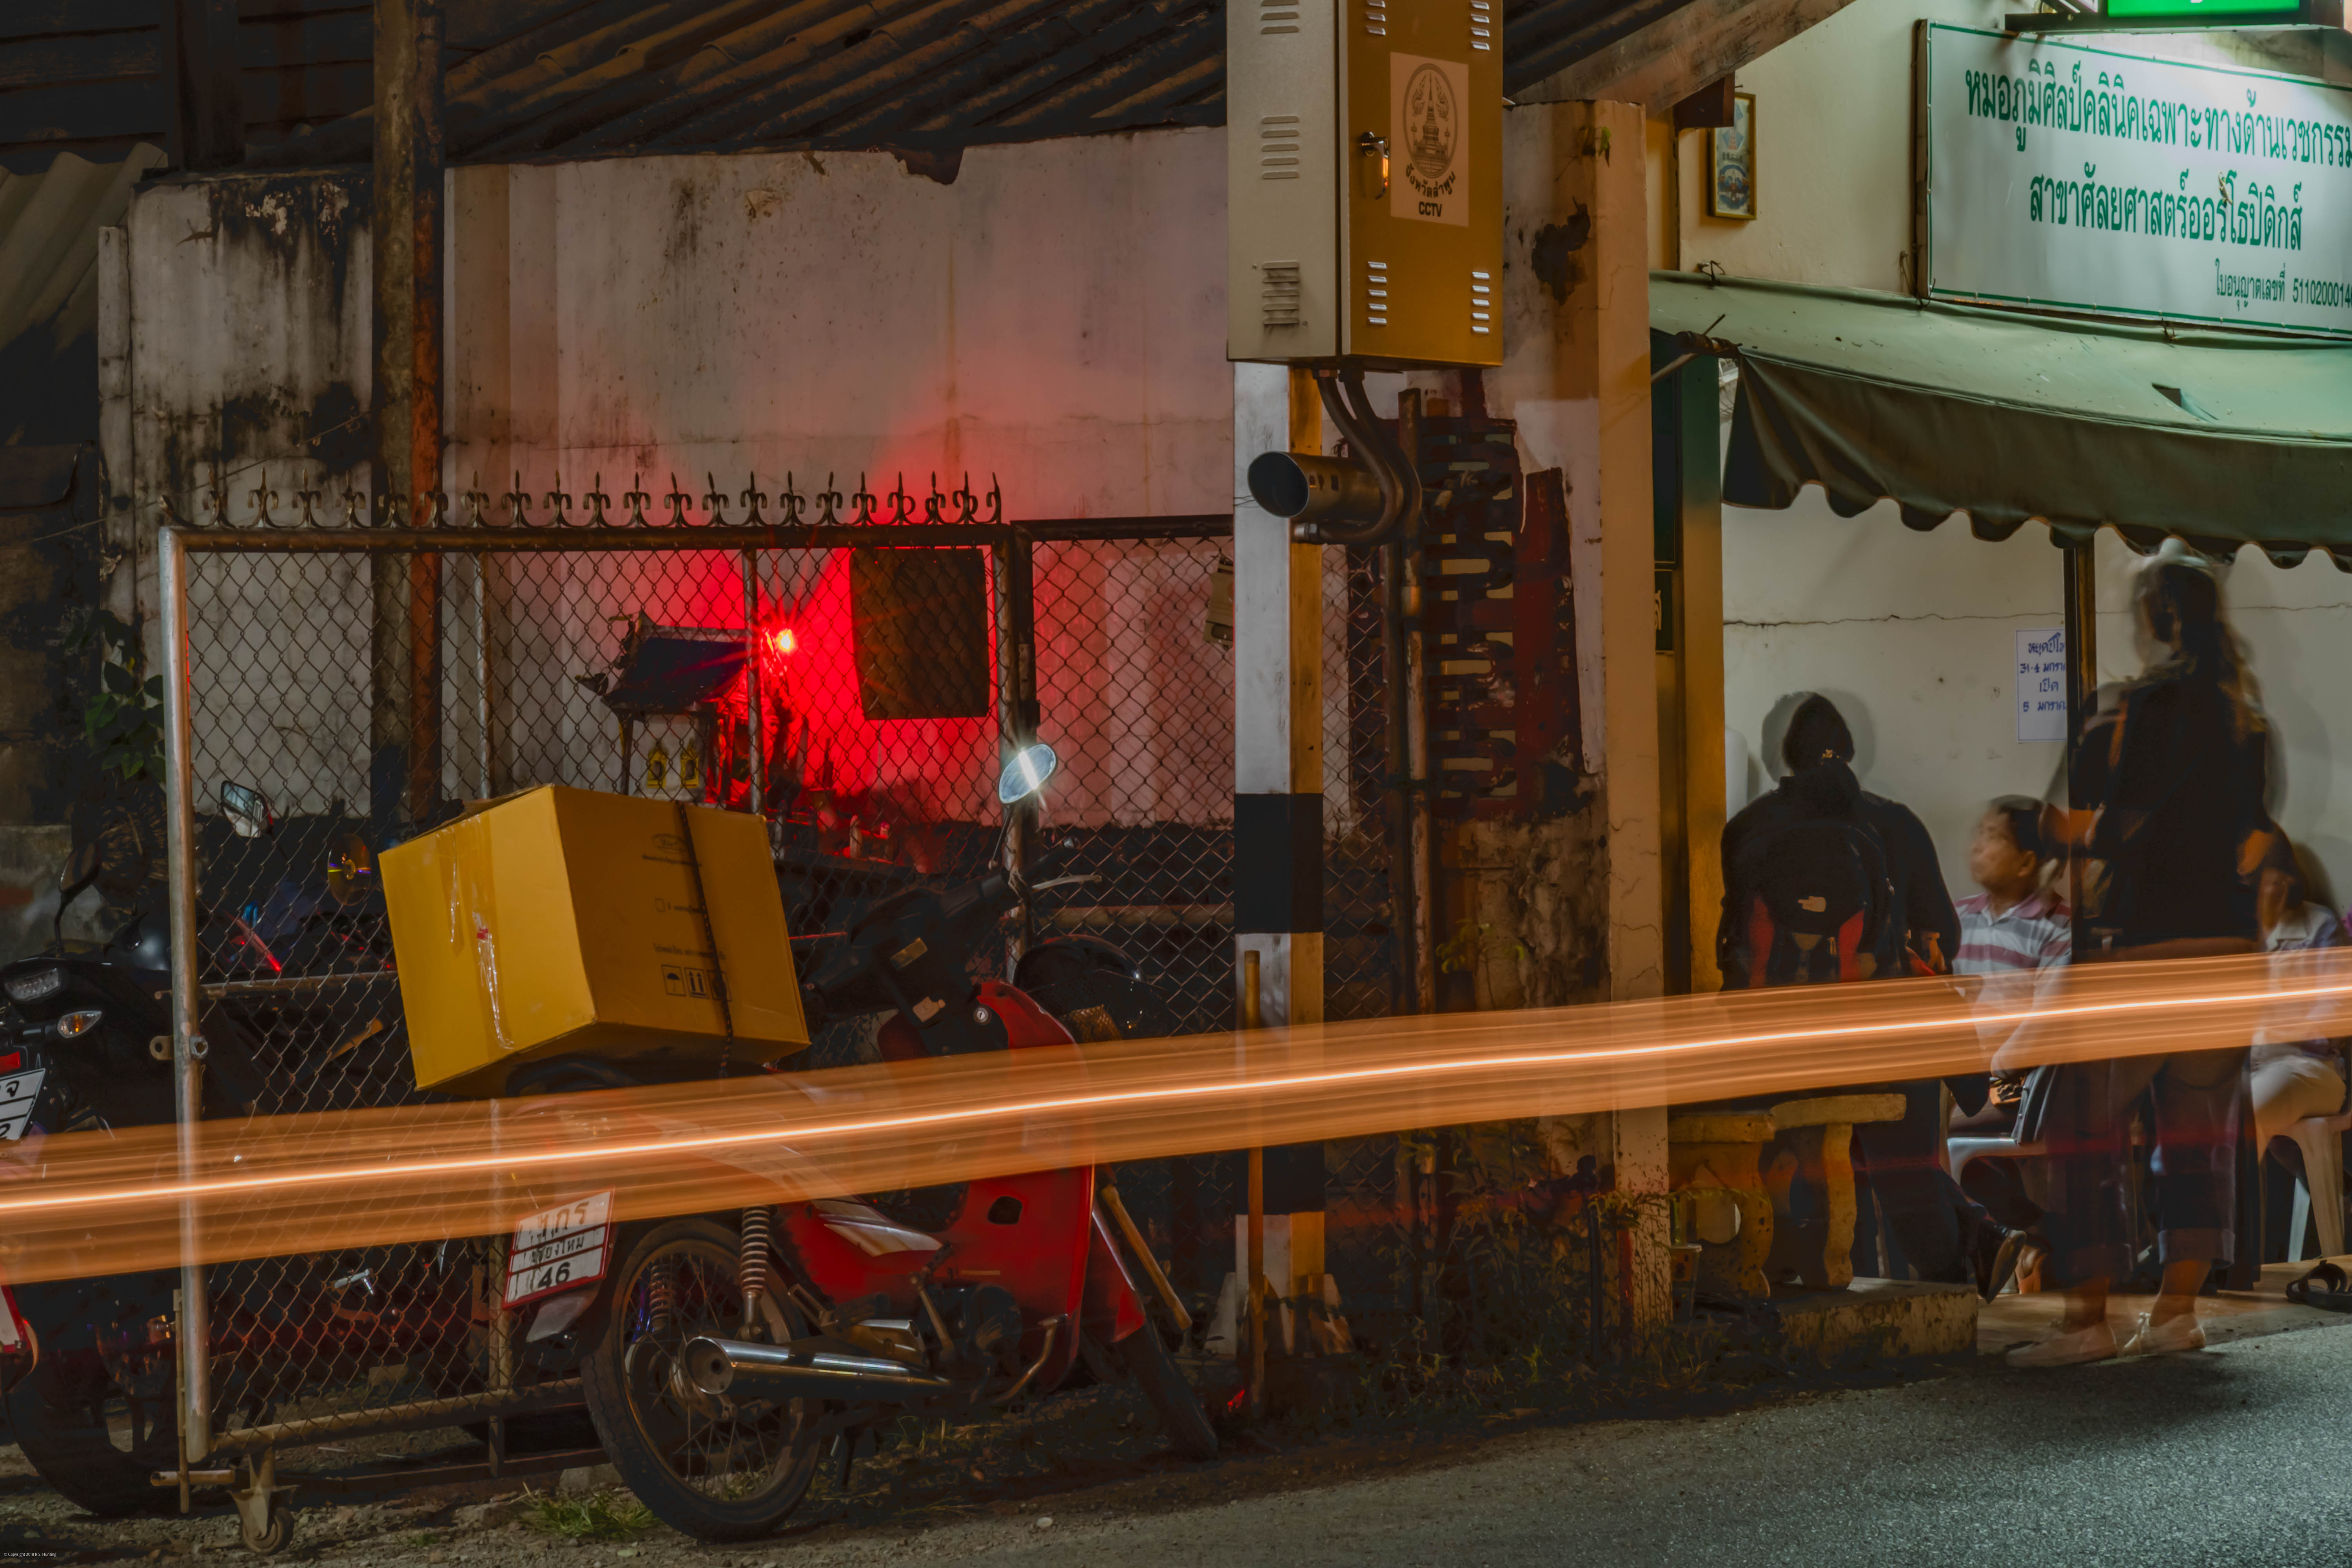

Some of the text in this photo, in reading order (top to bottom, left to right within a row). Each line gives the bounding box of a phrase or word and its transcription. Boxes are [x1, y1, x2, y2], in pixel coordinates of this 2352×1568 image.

[1418, 201, 1443, 217] CCTV
[2215, 258, 2352, 311] ใบอนุญาตเลขที่ 5110200014
[2040, 677, 2058, 692] เปิด
[2023, 701, 2029, 712] 5
[537, 1262, 571, 1288] 46
